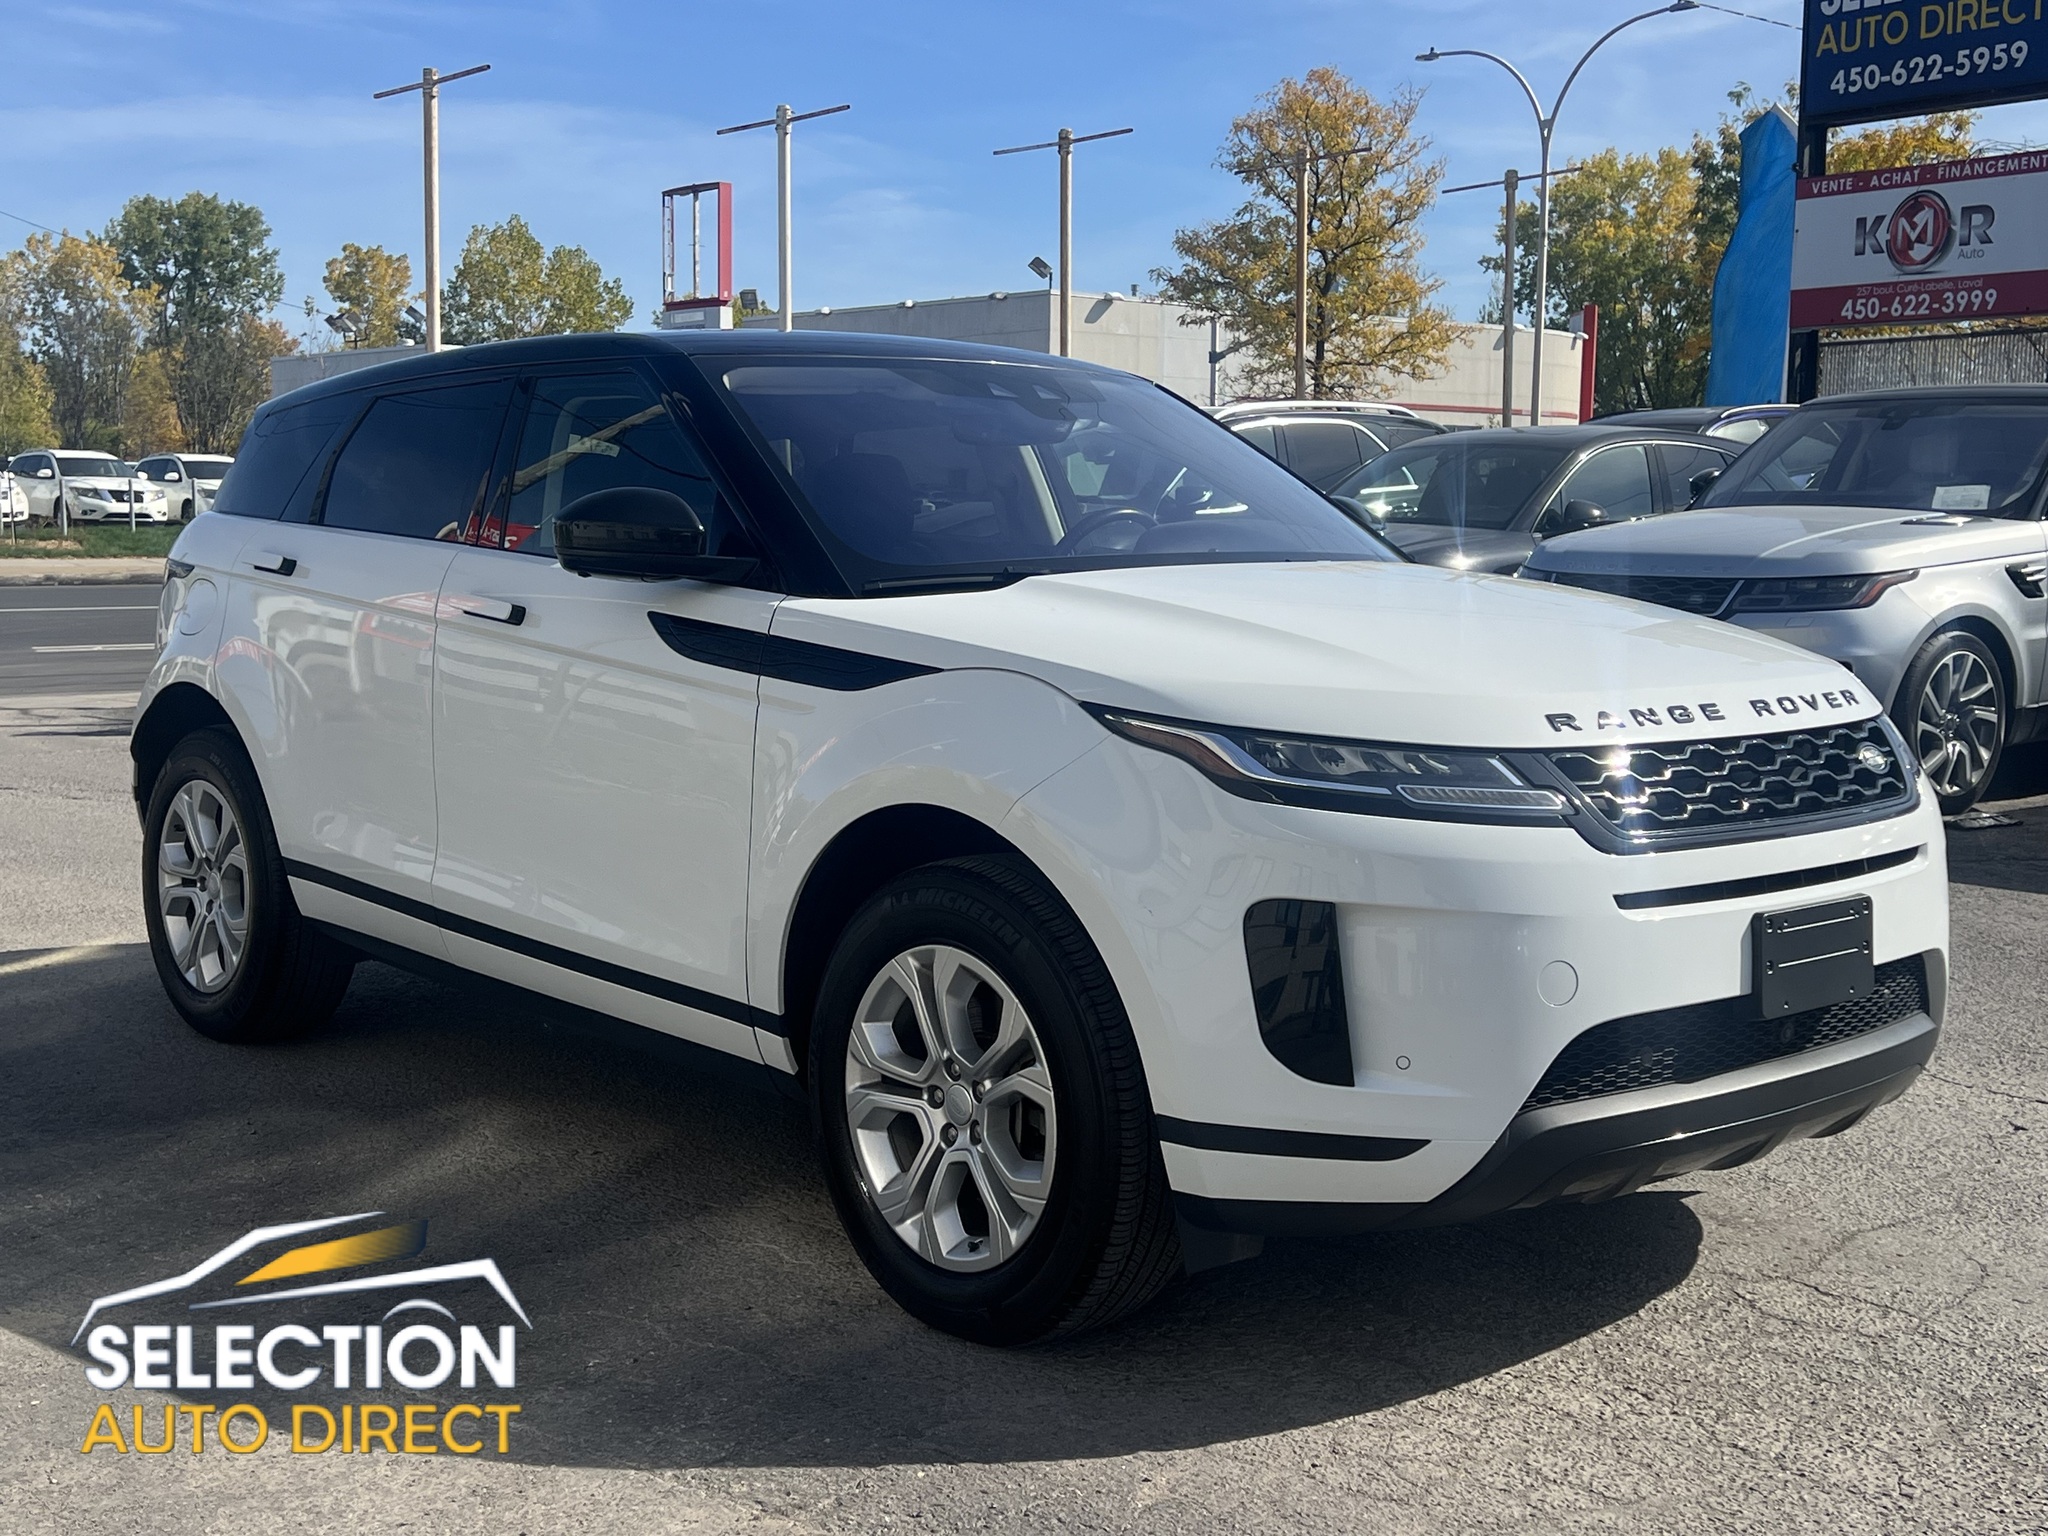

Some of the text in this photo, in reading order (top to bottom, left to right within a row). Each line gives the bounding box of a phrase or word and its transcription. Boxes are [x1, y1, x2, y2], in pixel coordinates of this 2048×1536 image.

[1816, 10, 1909, 57] AUTO
[1830, 40, 2029, 94] 450-622-5959
[1811, 177, 1853, 194] VENTE
[1870, 169, 1920, 187] ACHAT
[1938, 155, 2048, 180] FINANCEMENT
[1957, 248, 1985, 260] Auto
[1841, 288, 1998, 320] 450-622-3999
[1857, 286, 1872, 296] 257
[1958, 278, 1984, 288] Laval
[1544, 689, 1860, 732] RANGE ROVER
[915, 887, 1021, 946] MICHELIN
